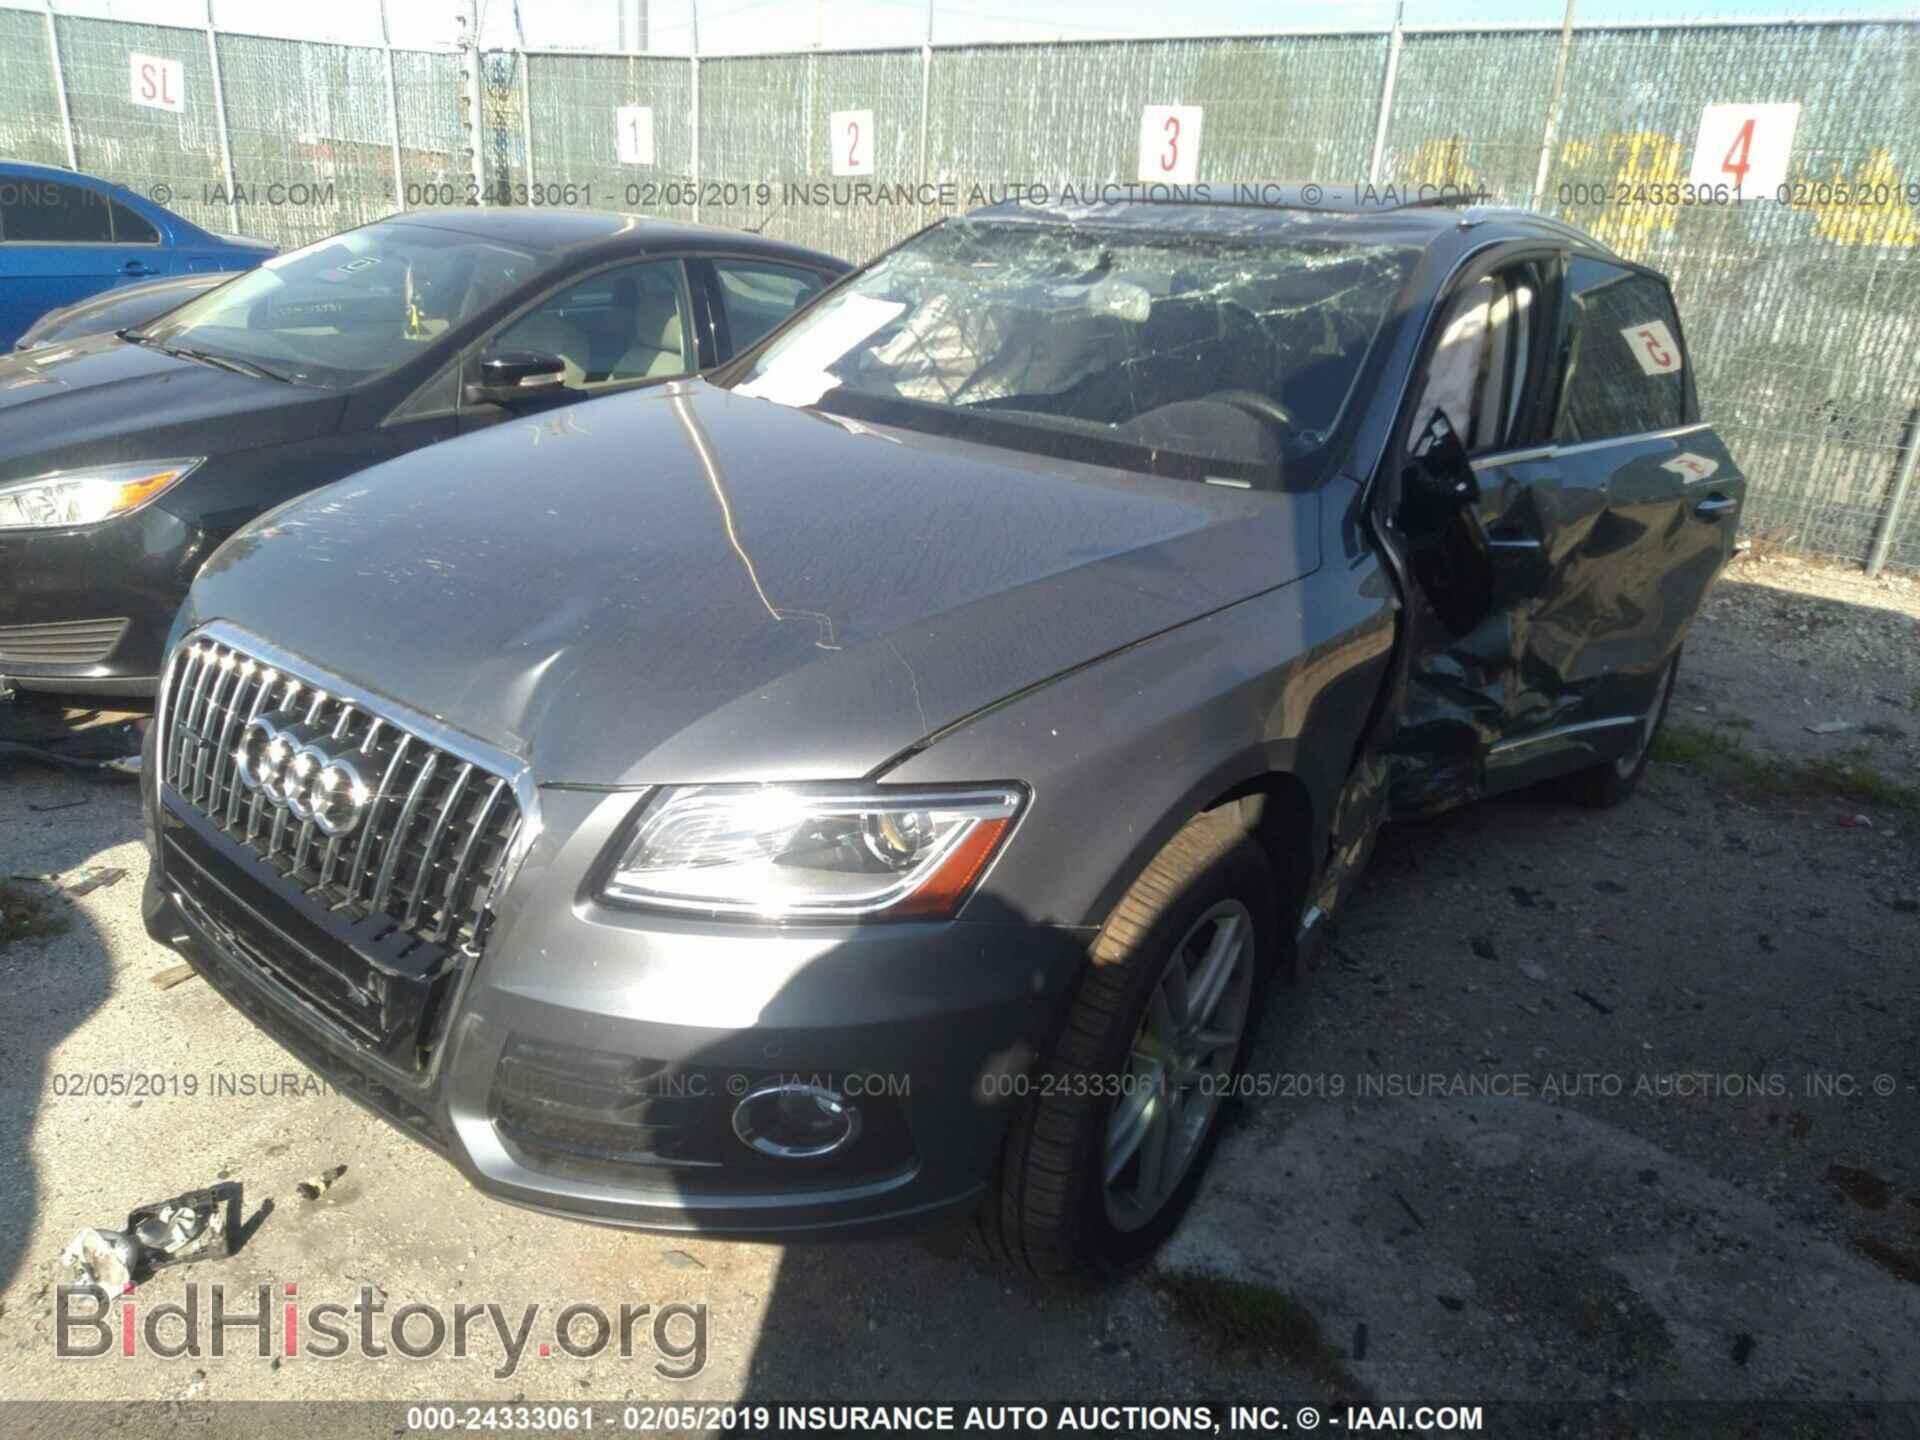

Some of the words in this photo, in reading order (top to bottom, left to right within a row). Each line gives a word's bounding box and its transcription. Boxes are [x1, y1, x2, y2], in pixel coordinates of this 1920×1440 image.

[141, 63, 176, 104] SL
[629, 116, 638, 155] 1
[847, 121, 860, 166] 2
[1160, 115, 1180, 171] 3
[1721, 118, 1756, 190] 4
